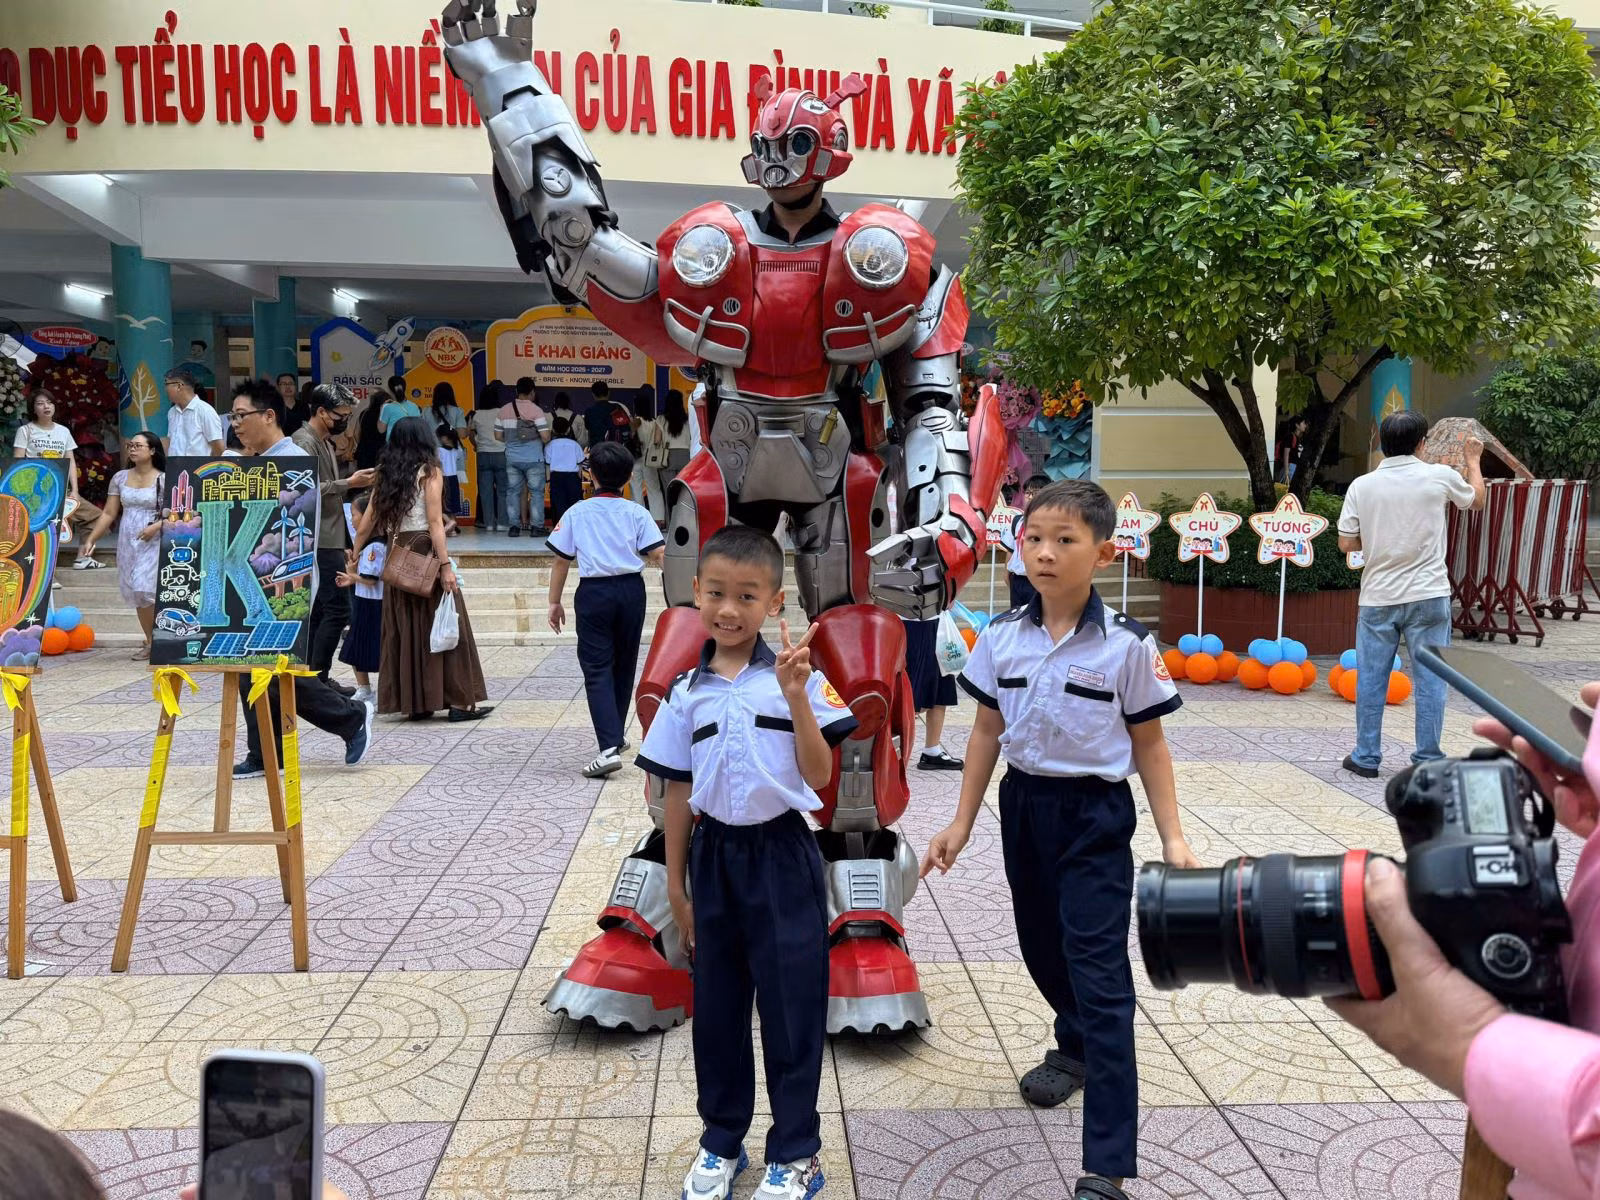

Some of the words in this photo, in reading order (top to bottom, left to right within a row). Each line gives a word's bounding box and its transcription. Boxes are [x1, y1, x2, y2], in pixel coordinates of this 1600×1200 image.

[29, 45, 107, 140] DỤC
[115, 10, 205, 124] TIỂU
[214, 42, 298, 139] HỌC
[309, 28, 363, 126] LÀ
[374, 19, 481, 127] NIỀM
[575, 28, 656, 134] CỦA
[669, 55, 736, 139] GIA
[850, 58, 896, 151] VÀ
[906, 67, 956, 155] XÃ
[514, 335, 534, 358] LỄ
[538, 344, 576, 359] KHAI
[580, 341, 631, 360] GIẢNG
[1263, 520, 1311, 534] TƯƠNG
